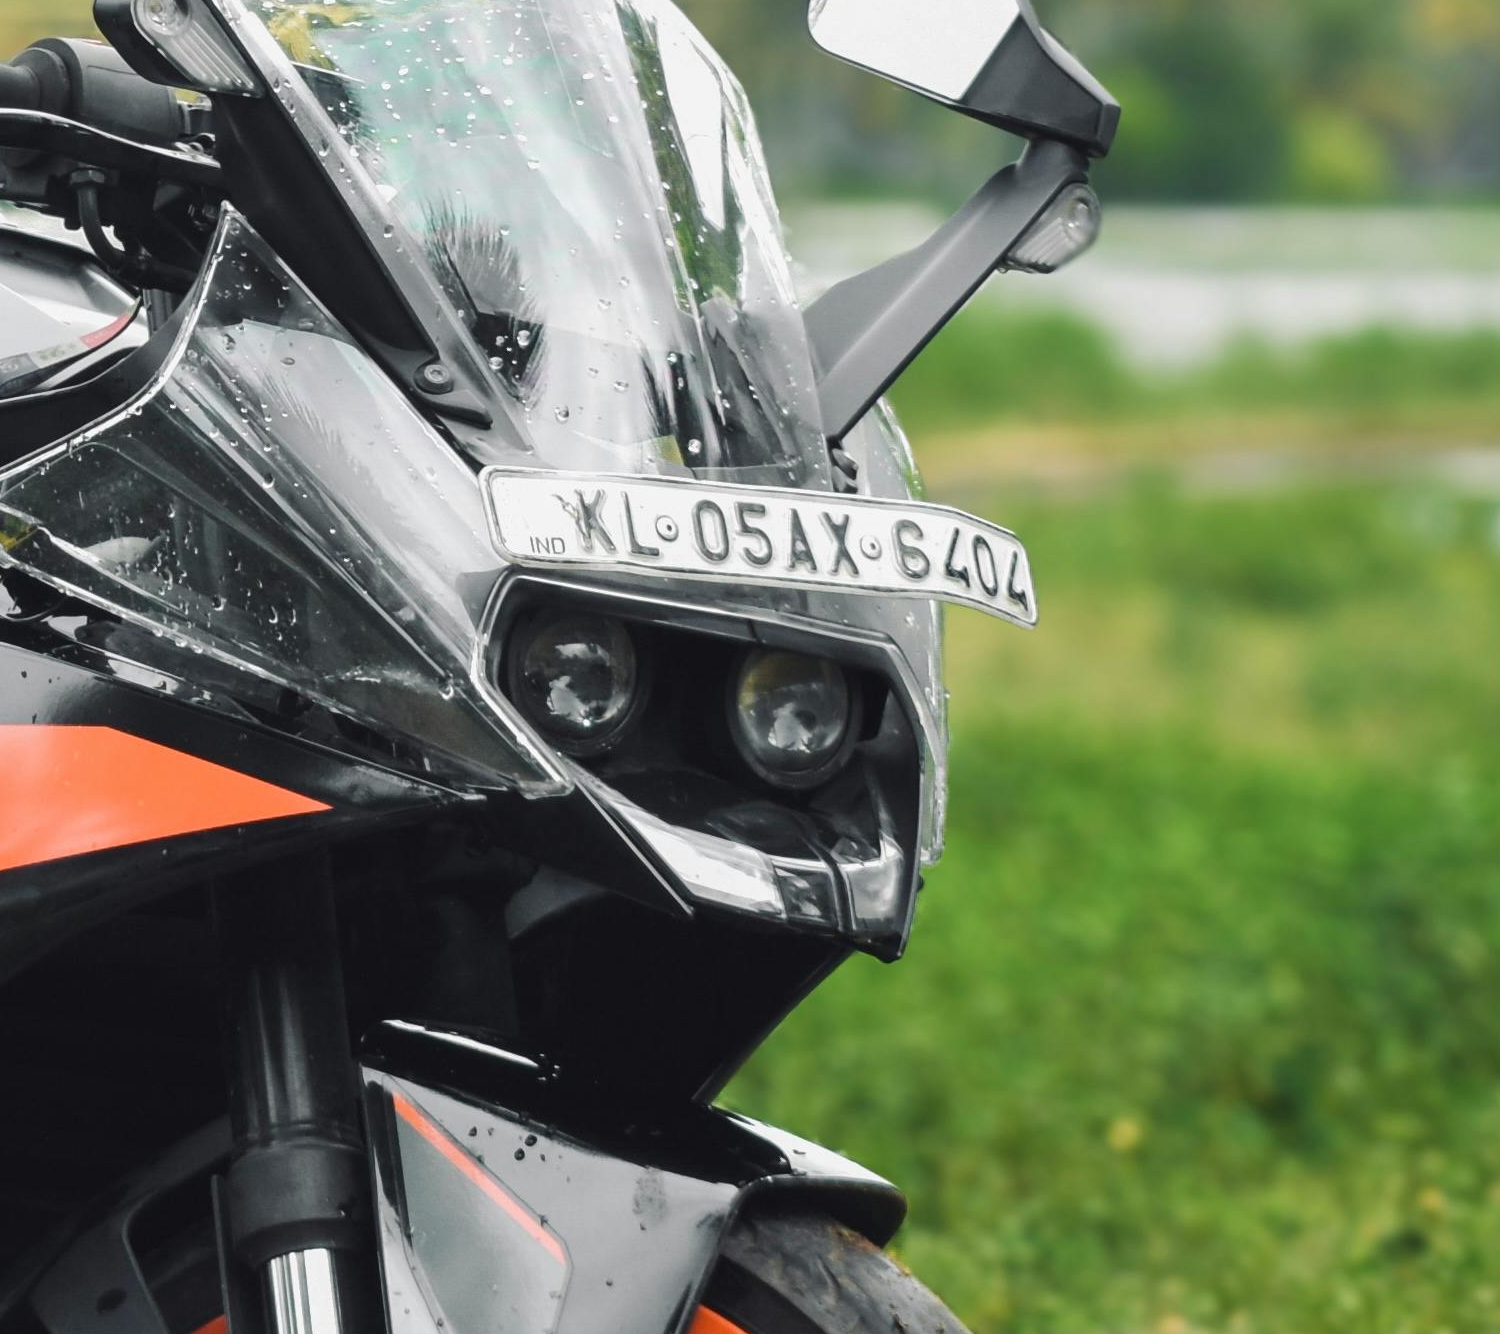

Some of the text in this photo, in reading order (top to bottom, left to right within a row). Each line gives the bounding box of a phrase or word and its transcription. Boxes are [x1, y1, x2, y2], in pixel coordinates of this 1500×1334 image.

[529, 535, 567, 556] IND
[574, 487, 660, 559] KL
[891, 517, 1032, 612] 6404
